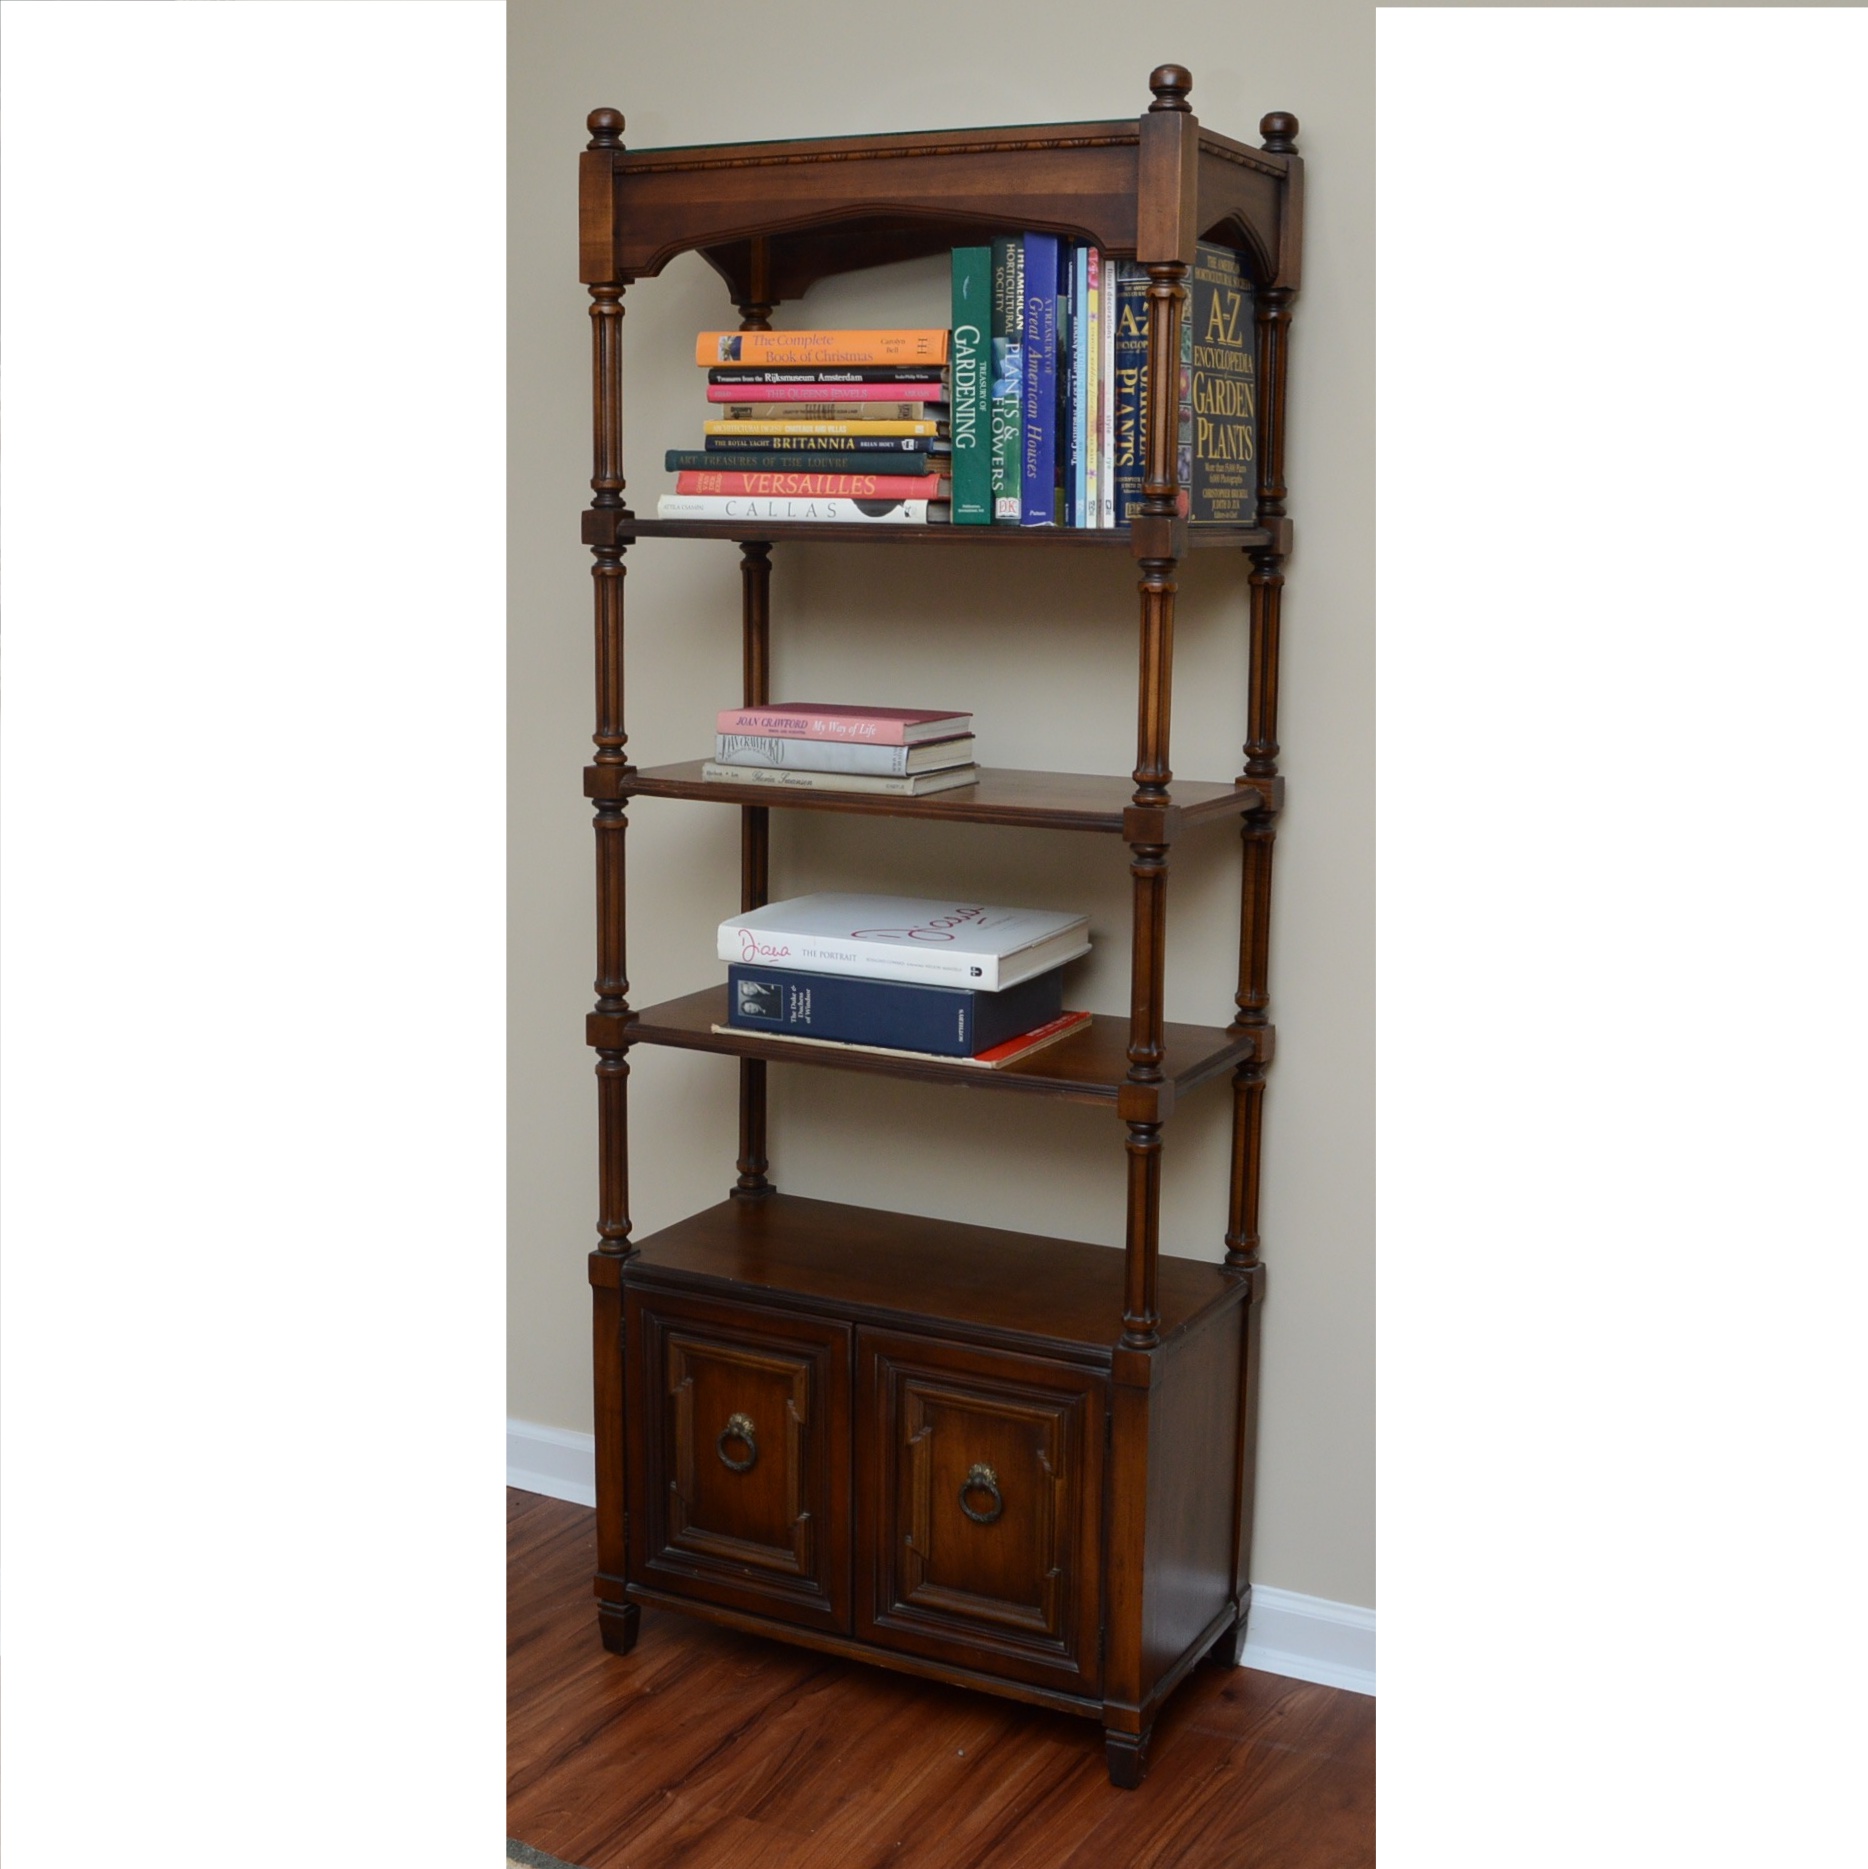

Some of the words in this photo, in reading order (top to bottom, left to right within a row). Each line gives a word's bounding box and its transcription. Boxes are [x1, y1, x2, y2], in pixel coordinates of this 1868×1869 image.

[1005, 244, 1015, 334] HORTICULTURAL
[1016, 274, 1024, 330] AMERICAN
[1028, 297, 1044, 340] Great
[1205, 288, 1242, 348] A-Z
[753, 334, 778, 346] The
[779, 334, 834, 349] Complete
[1044, 306, 1052, 360] TREASURY
[766, 352, 796, 362] Book
[800, 351, 812, 362] of
[815, 350, 874, 362] Christmas
[1194, 346, 1254, 374] ENCYCLOPEDIA
[764, 372, 815, 383] Rijksmuseum
[818, 372, 863, 382] Amsterdam
[954, 325, 980, 449] GARDENING
[1004, 343, 1020, 418] PLANTS
[1028, 346, 1043, 418] American
[766, 389, 785, 398] THE
[830, 388, 868, 401] JEWELS
[1193, 370, 1254, 418] GARDEN
[980, 402, 986, 412] OF
[1116, 368, 1138, 466] PLANTS
[773, 437, 856, 450] BRITANNIA
[992, 397, 1004, 491] FLOWERS
[1004, 426, 1019, 442] &
[1196, 417, 1253, 461] PLANTS
[1026, 424, 1042, 478] Houses
[680, 456, 698, 465] ART
[702, 456, 758, 466] TREASURES
[762, 457, 775, 466] OF
[782, 457, 802, 467] THE
[808, 458, 848, 468] LOUVRE
[742, 474, 876, 495] VERSAILLES
[725, 500, 836, 518] CALLAS
[1000, 500, 1017, 514] DK
[736, 716, 758, 726] JOAN
[761, 718, 808, 729] CRAWFORD
[812, 720, 825, 734] My
[828, 721, 846, 736] Way
[848, 722, 858, 736] of
[860, 724, 877, 738] Life
[778, 772, 813, 786] Swanson
[738, 929, 791, 962] Diana
[802, 949, 817, 958] THE
[820, 951, 858, 962] PORTRAIT
[804, 1016, 812, 1024] of
